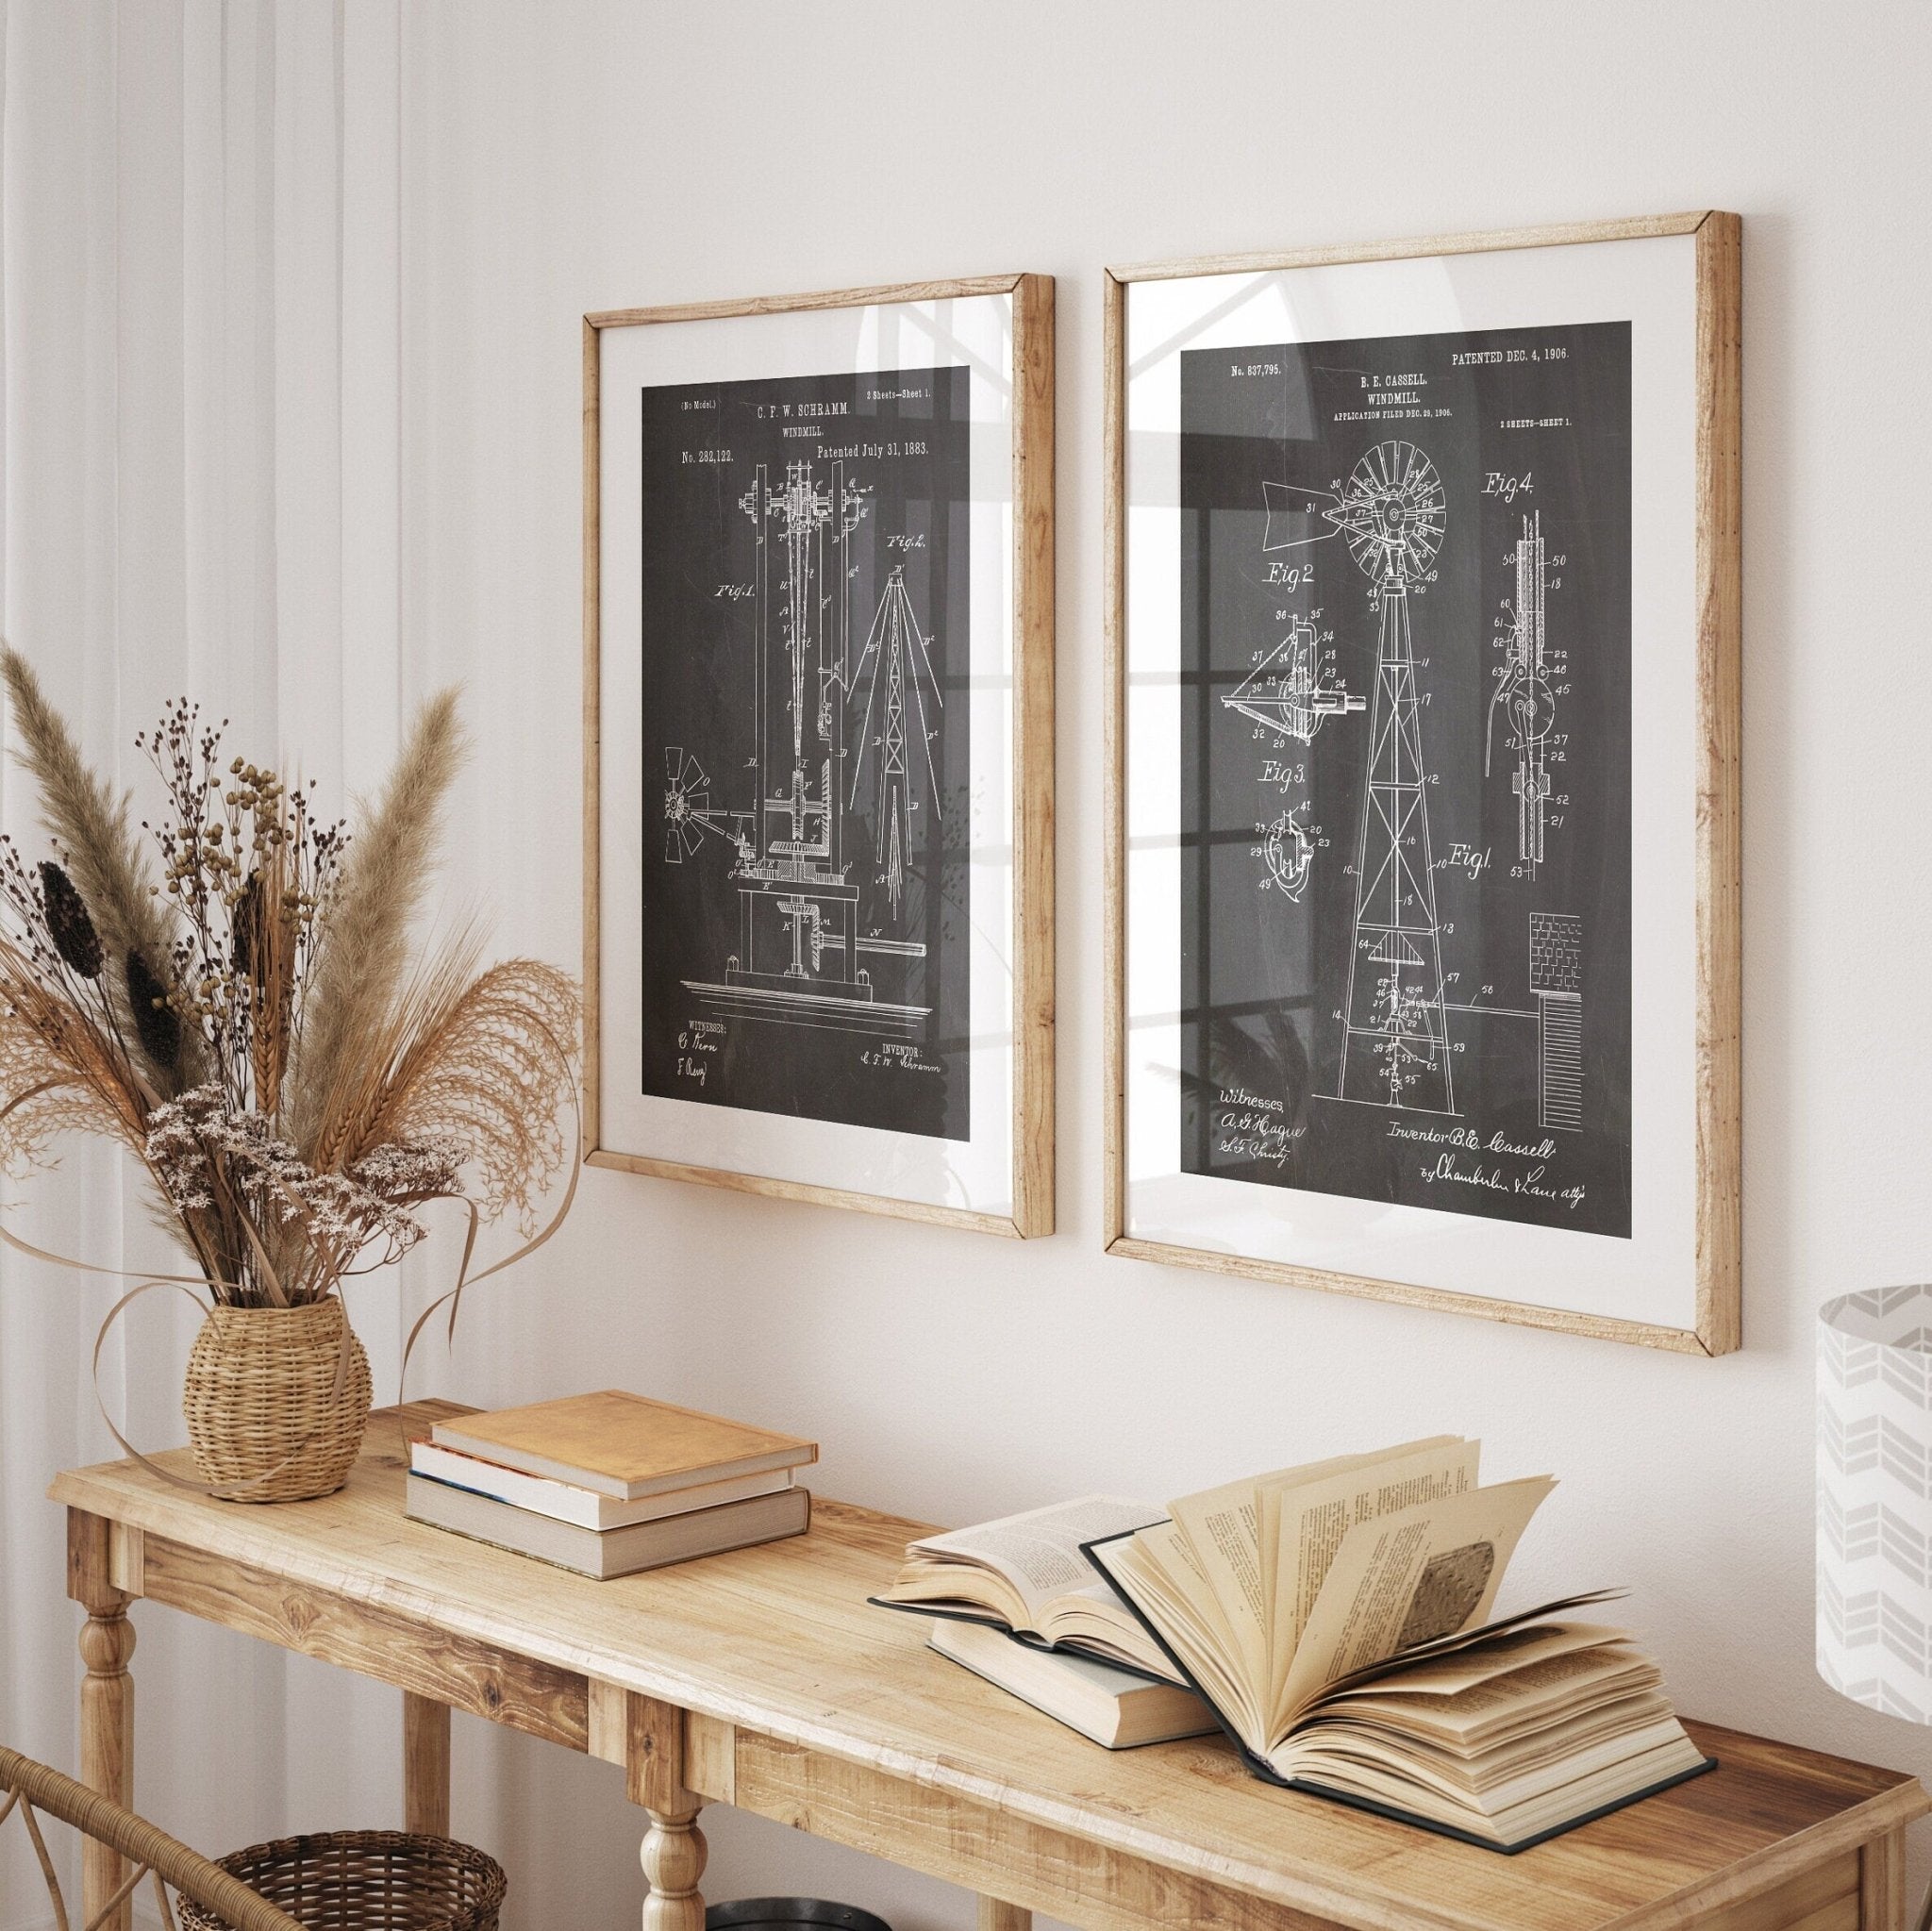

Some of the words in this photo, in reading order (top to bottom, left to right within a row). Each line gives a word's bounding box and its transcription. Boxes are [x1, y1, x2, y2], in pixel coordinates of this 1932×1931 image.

[1452, 351, 1503, 366] PATENTED
[1507, 350, 1528, 362] DEC.
[1531, 349, 1541, 362] 4,
[1544, 347, 1570, 359] 1906.
[1230, 365, 1244, 376] No.
[1247, 364, 1281, 376] 837,795.
[1360, 376, 1369, 388] B.
[1373, 375, 1382, 388] E.
[1385, 374, 1427, 387] CASSELL.
[866, 391, 872, 400] 2
[1367, 391, 1421, 406] WINDMILL.
[757, 407, 766, 418] C.
[770, 406, 778, 418] F.
[782, 405, 793, 417] W.
[798, 402, 851, 417] SCHRAMM.
[1333, 410, 1380, 422] APPLICATION
[1382, 409, 1404, 419] FILED
[1406, 408, 1423, 419] DEC.
[782, 425, 824, 438] WINDMILL.
[817, 443, 858, 458] Patented
[862, 443, 883, 458] July
[887, 442, 901, 457] 31,
[905, 441, 928, 455] 1883.
[681, 451, 695, 463] No.
[698, 450, 734, 463] 282,122.
[1306, 503, 1316, 513] 31
[1551, 577, 1561, 590] 18
[1414, 585, 1426, 594] 20
[1324, 649, 1337, 660] 28
[1554, 650, 1568, 658] 22
[1324, 667, 1337, 678] 23
[1251, 682, 1262, 693] 30
[1252, 728, 1265, 739] 32
[1273, 739, 1286, 748] 20
[1554, 734, 1569, 745] 37
[1550, 751, 1567, 761] 22
[1426, 774, 1440, 784] 12
[1309, 825, 1323, 835] 20
[1318, 838, 1330, 847] 23
